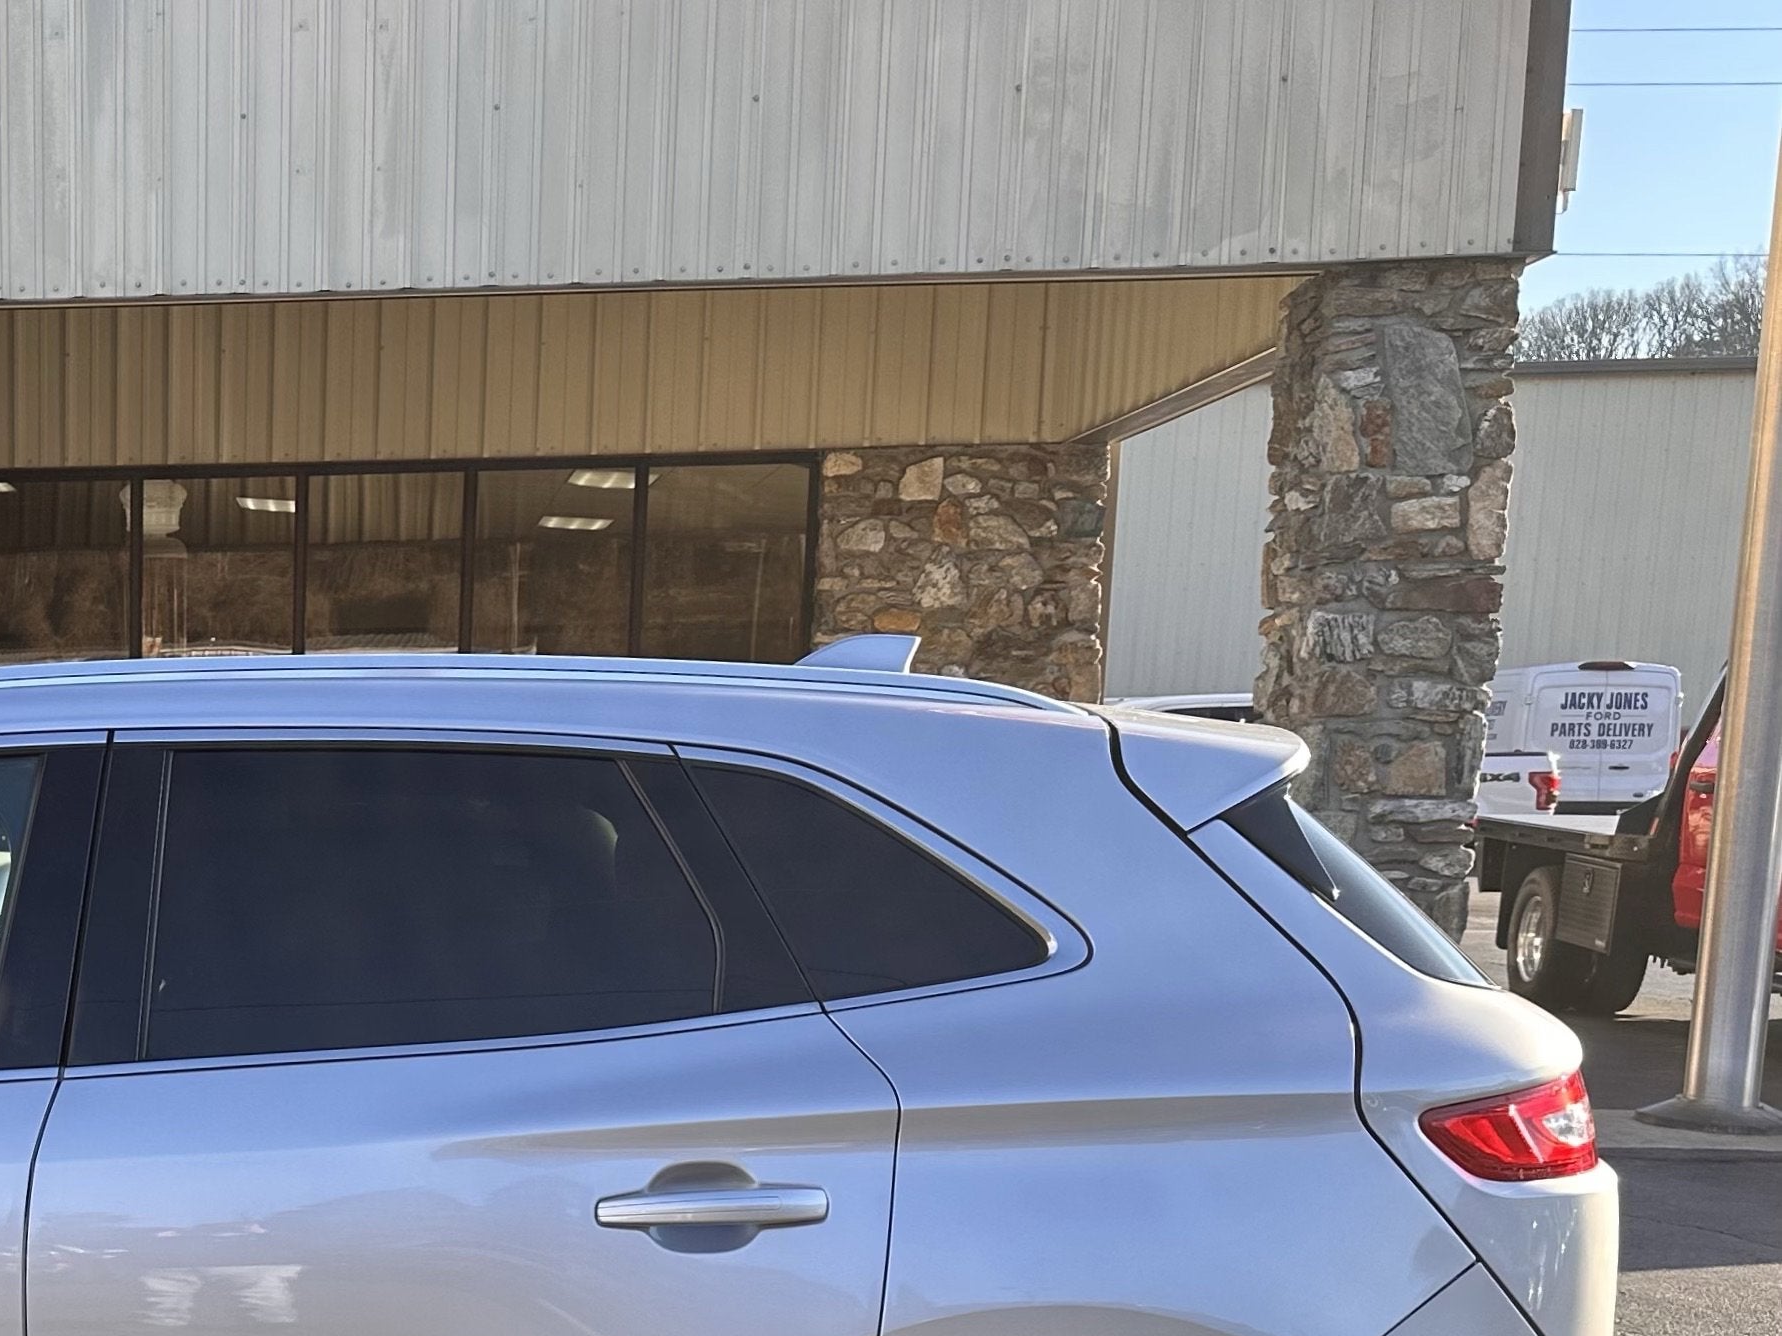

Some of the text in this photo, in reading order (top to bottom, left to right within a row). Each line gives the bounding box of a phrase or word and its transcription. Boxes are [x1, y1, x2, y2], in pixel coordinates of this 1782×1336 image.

[1560, 692, 1648, 710] JACKY JONES
[1585, 711, 1621, 721] FORD
[1550, 722, 1654, 737] PARTS DELIVERY
